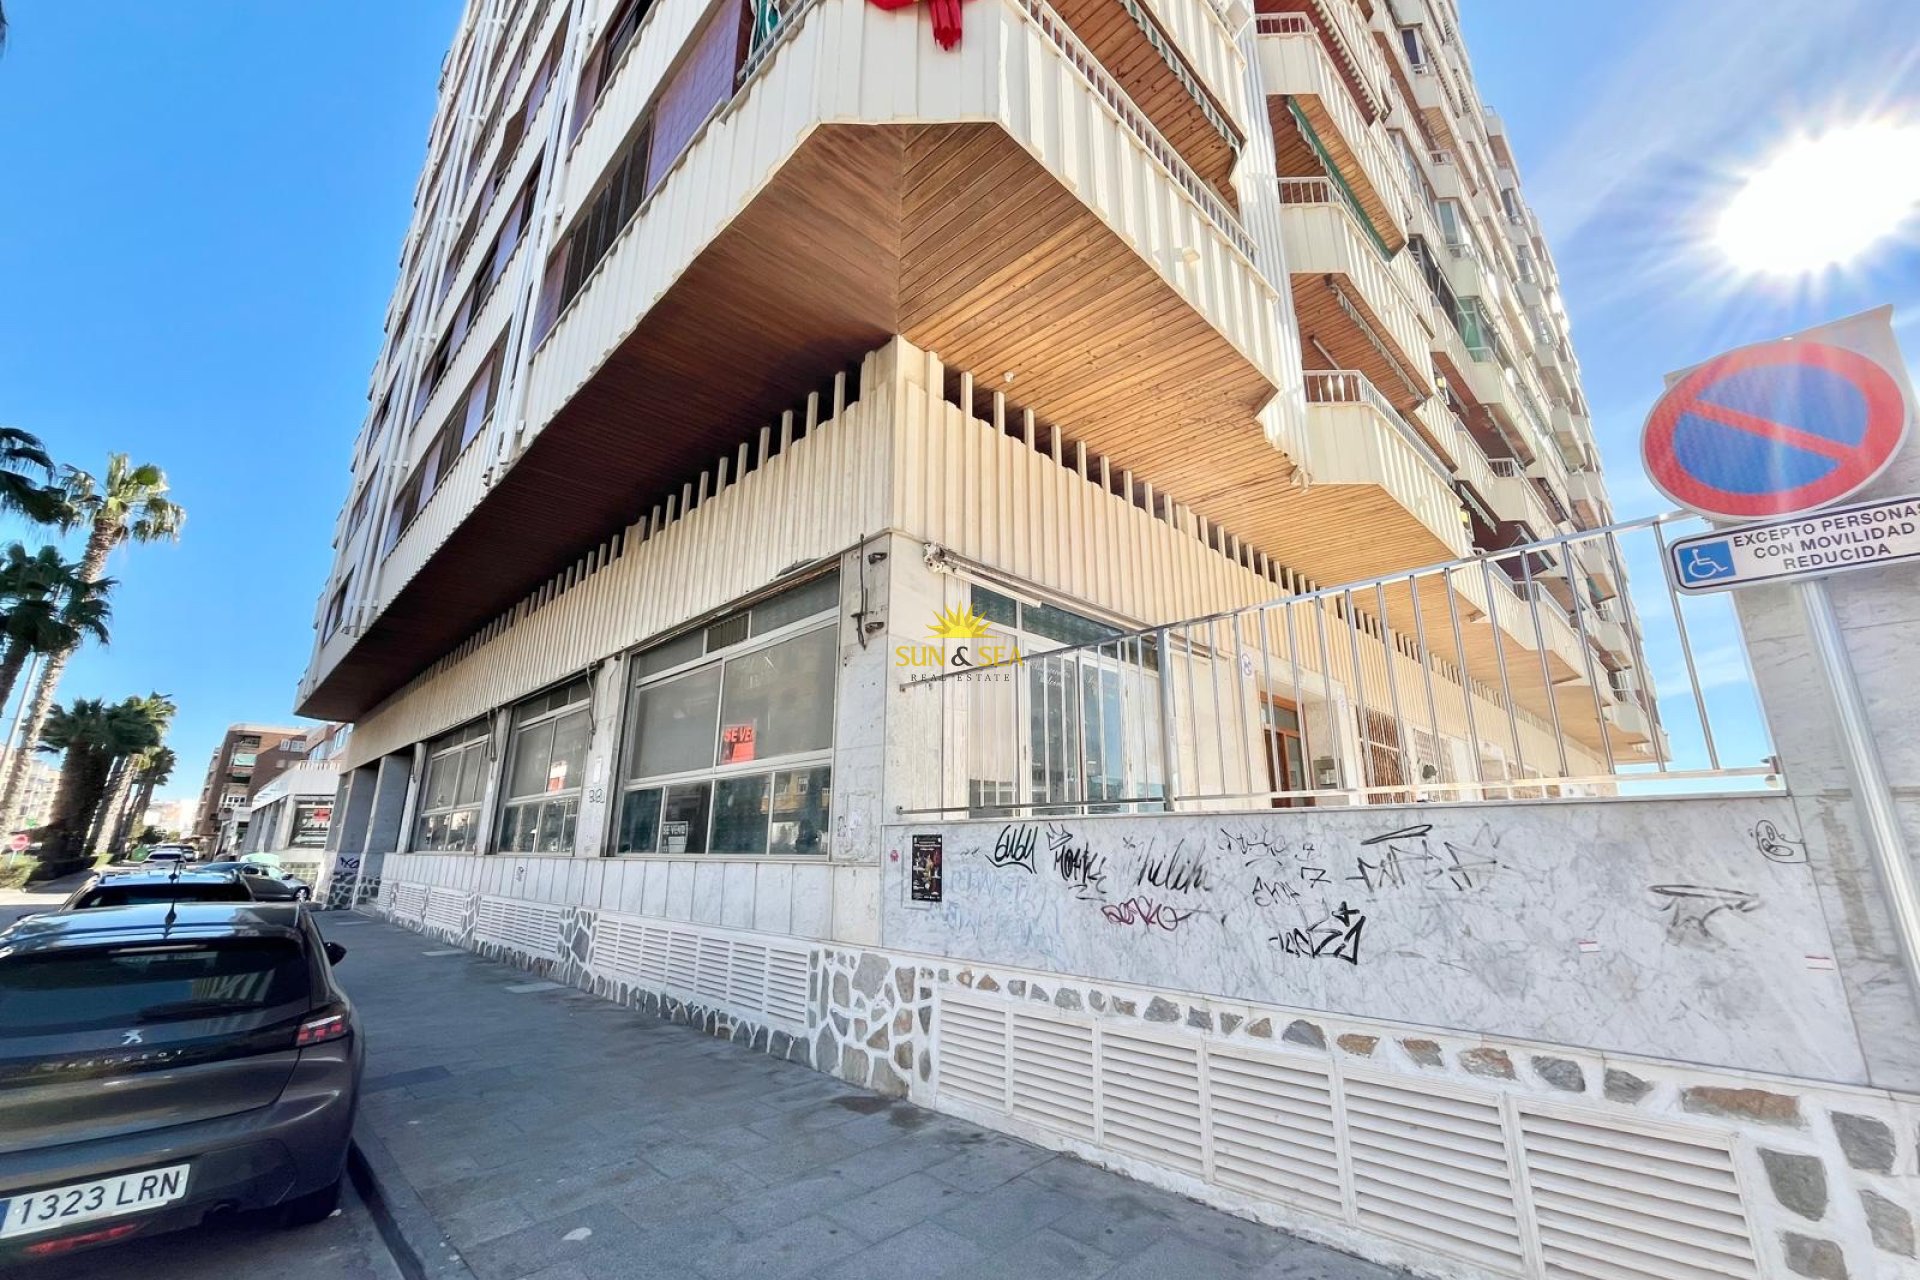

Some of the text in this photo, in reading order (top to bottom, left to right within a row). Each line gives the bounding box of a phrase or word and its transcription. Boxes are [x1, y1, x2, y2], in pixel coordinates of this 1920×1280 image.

[1733, 503, 1920, 547] EXCEPTO PERSONA
[1754, 522, 1915, 559] CON MOVILIDAD
[1783, 543, 1891, 570] REDUCIDA
[21, 1170, 181, 1225] 1323 LRN
